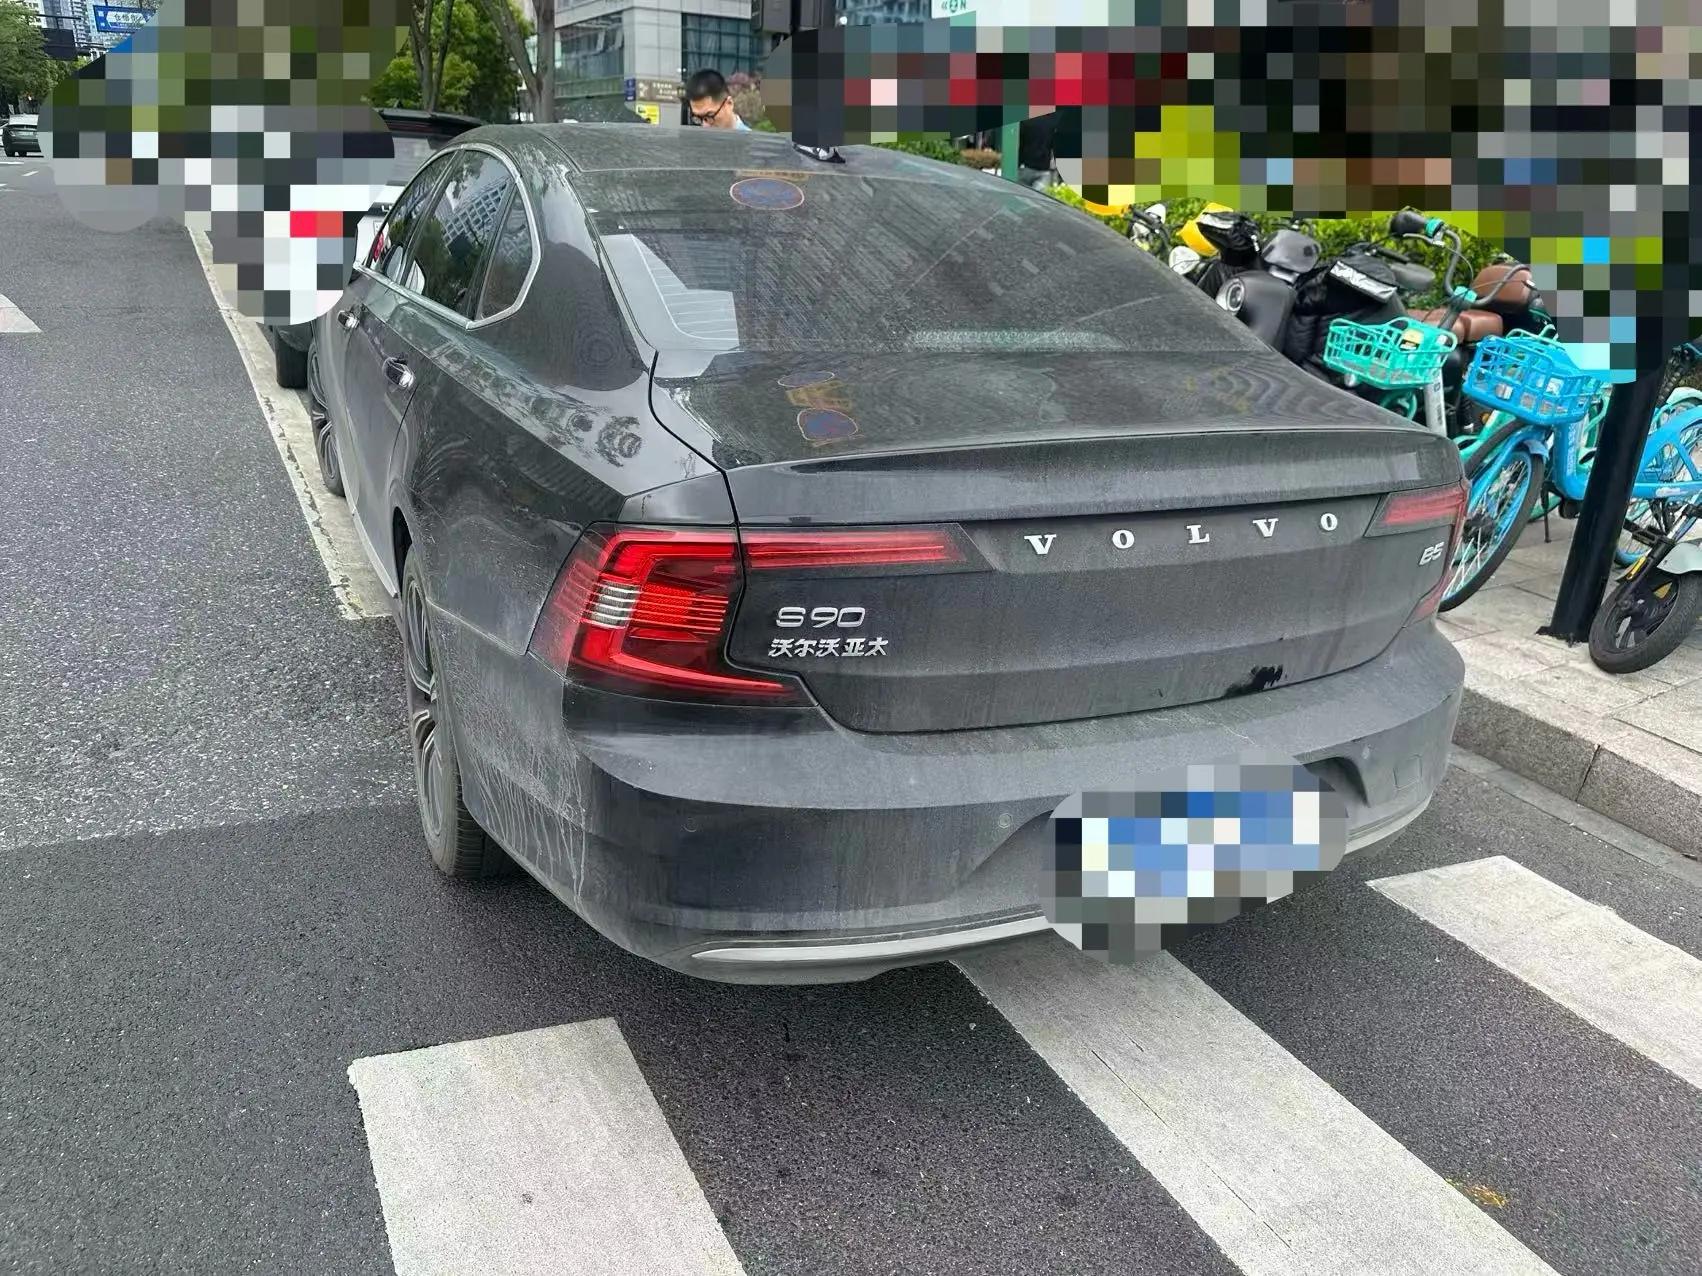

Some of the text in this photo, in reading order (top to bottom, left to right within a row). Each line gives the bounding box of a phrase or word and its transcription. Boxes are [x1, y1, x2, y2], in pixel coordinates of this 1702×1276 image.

[1024, 513, 1338, 555] VOLVO
[1419, 541, 1445, 566] B5
[776, 606, 866, 628] S90
[768, 637, 889, 658] 沃尔沃亚太
